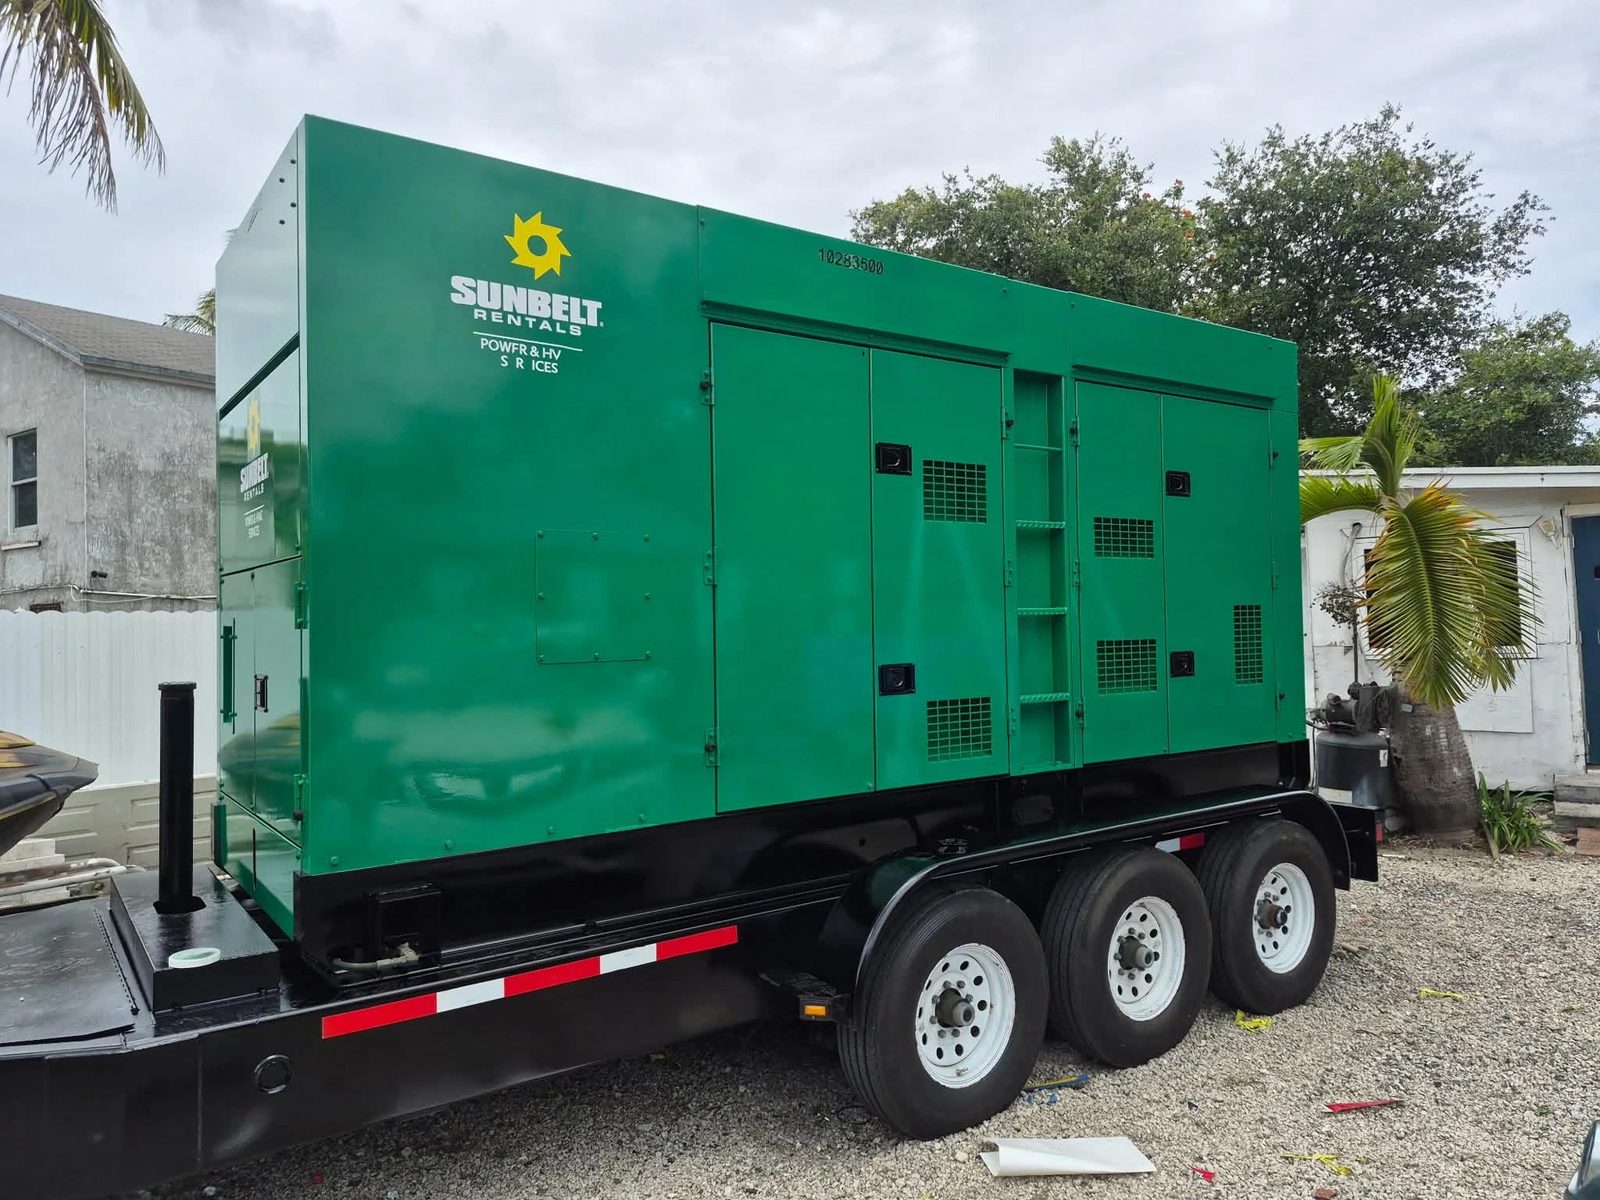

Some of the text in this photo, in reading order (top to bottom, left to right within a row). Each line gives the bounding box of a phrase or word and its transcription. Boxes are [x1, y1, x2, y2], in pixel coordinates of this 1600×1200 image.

[818, 248, 884, 275] 10283500
[450, 275, 603, 327] SUNBELT
[474, 308, 582, 336] RENTALS
[529, 345, 540, 358] &
[542, 347, 561, 360] HV
